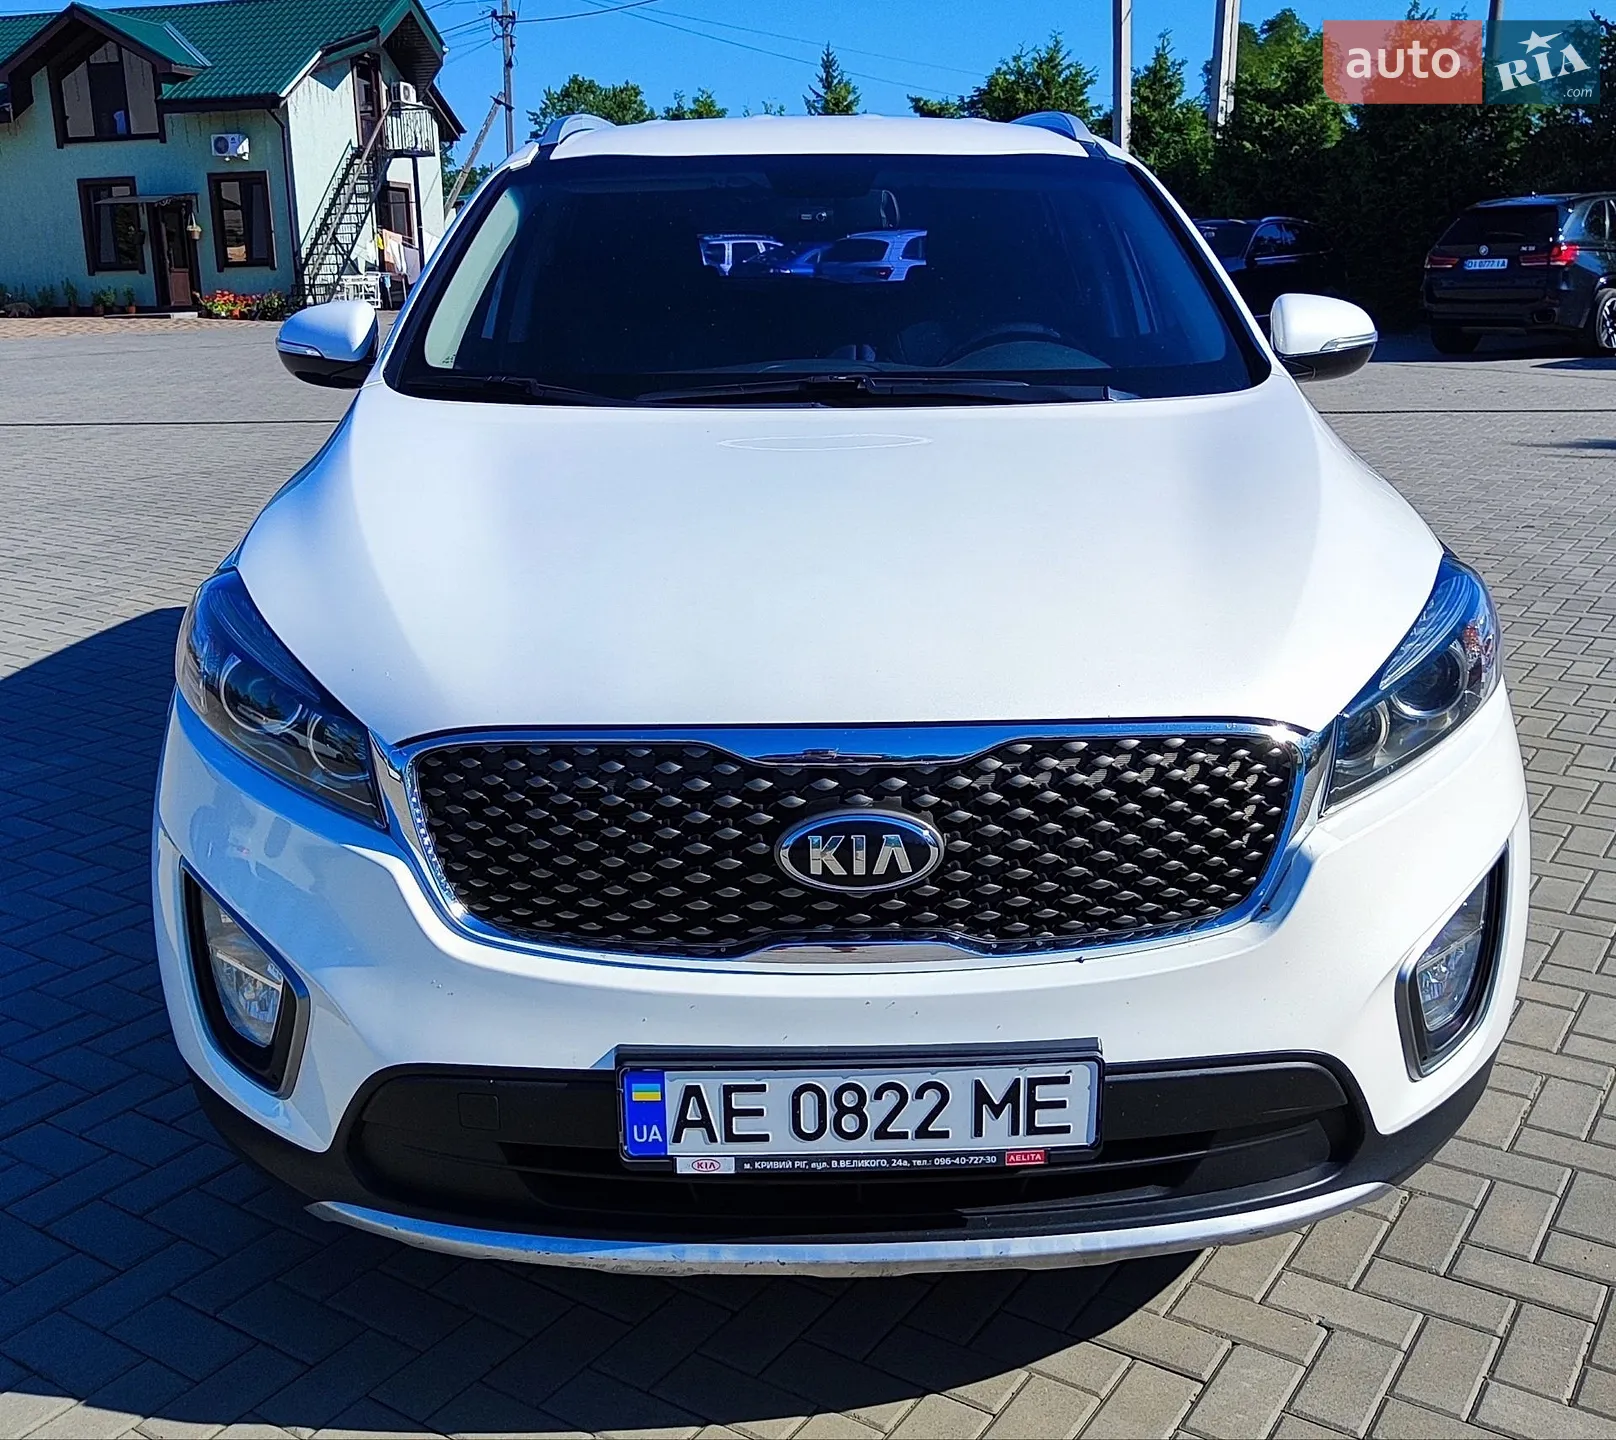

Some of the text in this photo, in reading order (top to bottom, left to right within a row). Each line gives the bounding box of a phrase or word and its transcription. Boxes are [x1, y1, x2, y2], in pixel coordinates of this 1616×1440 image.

[807, 834, 913, 876] KIA
[671, 1074, 1072, 1145] AE 0822 ME
[633, 1124, 663, 1143] UA
[697, 1161, 716, 1170] KIA
[754, 1159, 793, 1169] КРИВИЙ
[933, 1155, 997, 1166] 096-40-727-30
[1008, 1153, 1042, 1163] AELITA
